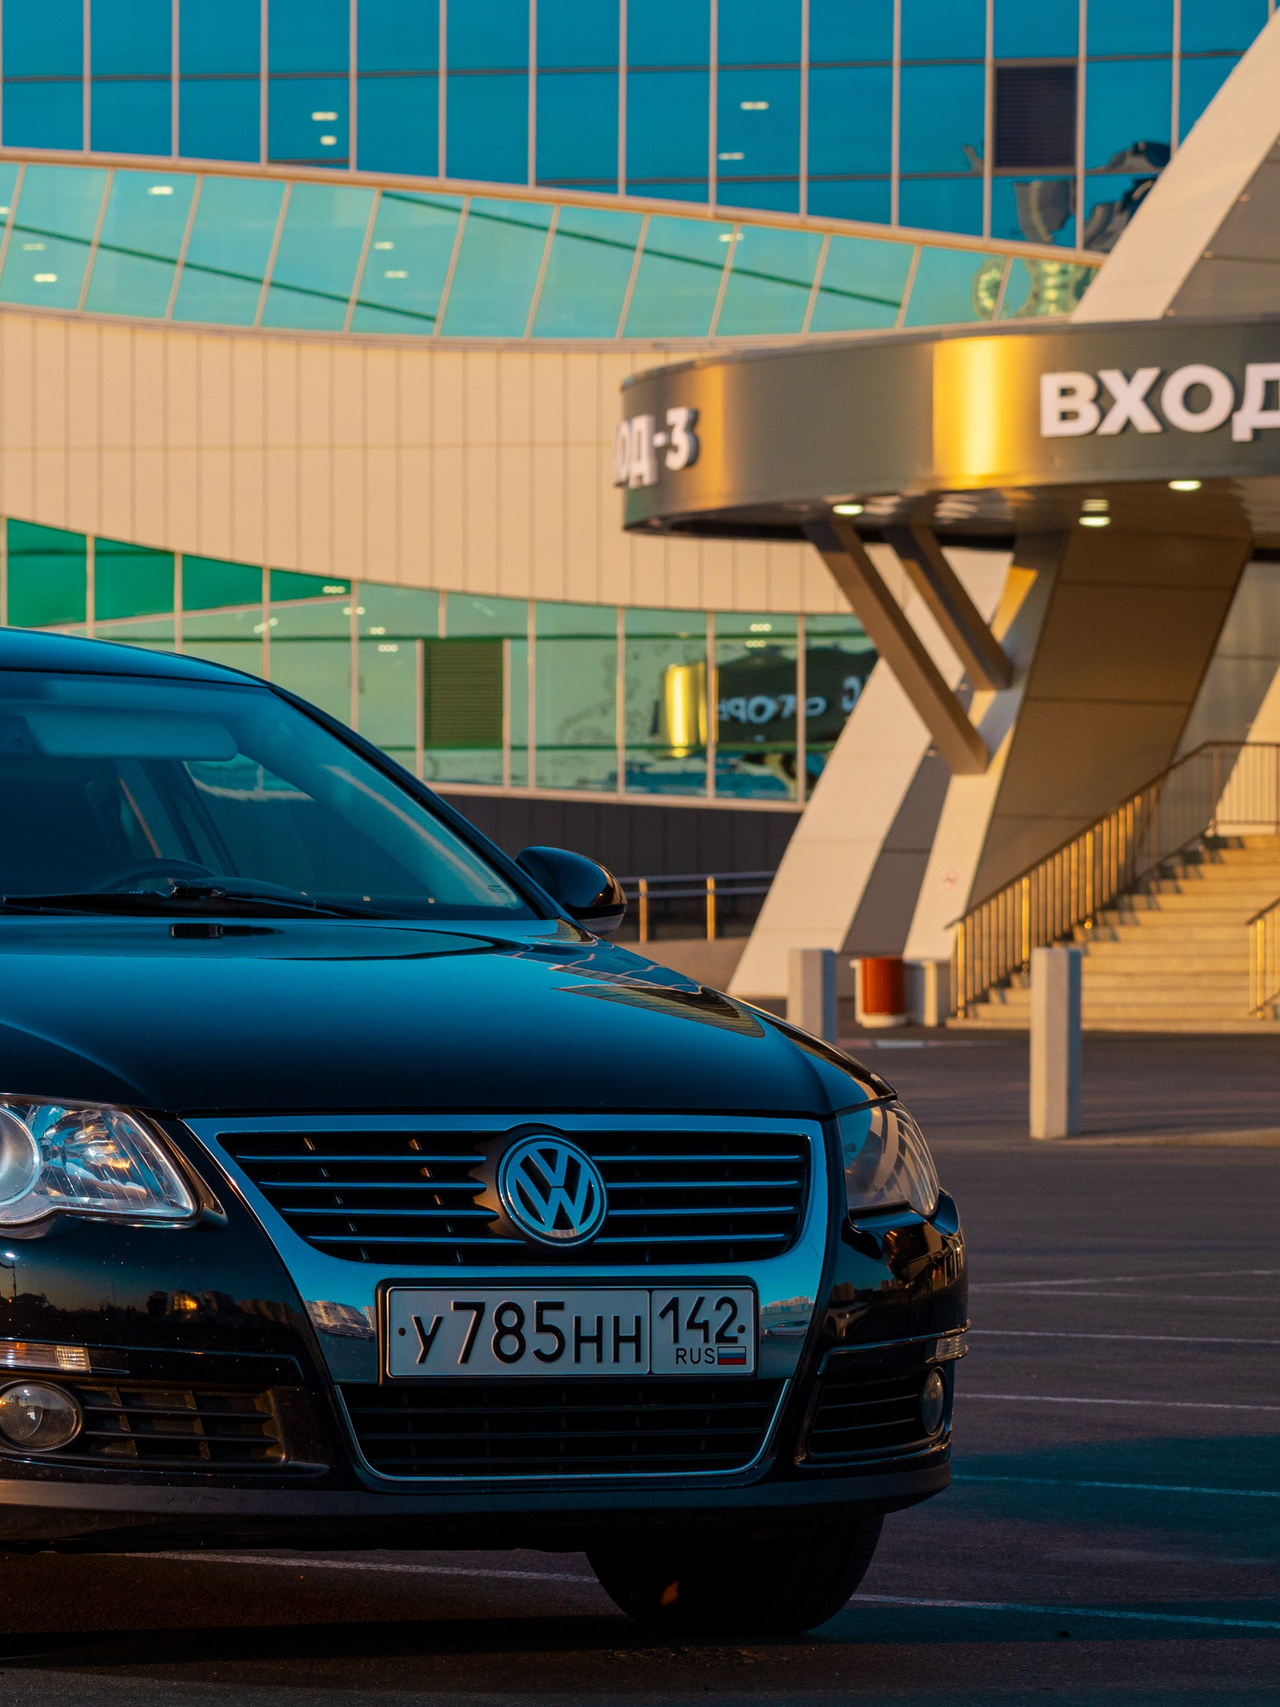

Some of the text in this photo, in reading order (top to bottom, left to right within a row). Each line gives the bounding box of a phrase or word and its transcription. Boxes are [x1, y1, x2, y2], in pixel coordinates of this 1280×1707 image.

[1040, 363, 1280, 442] ВХОД
[659, 1295, 739, 1344] 142
[675, 1347, 716, 1365] RUS
